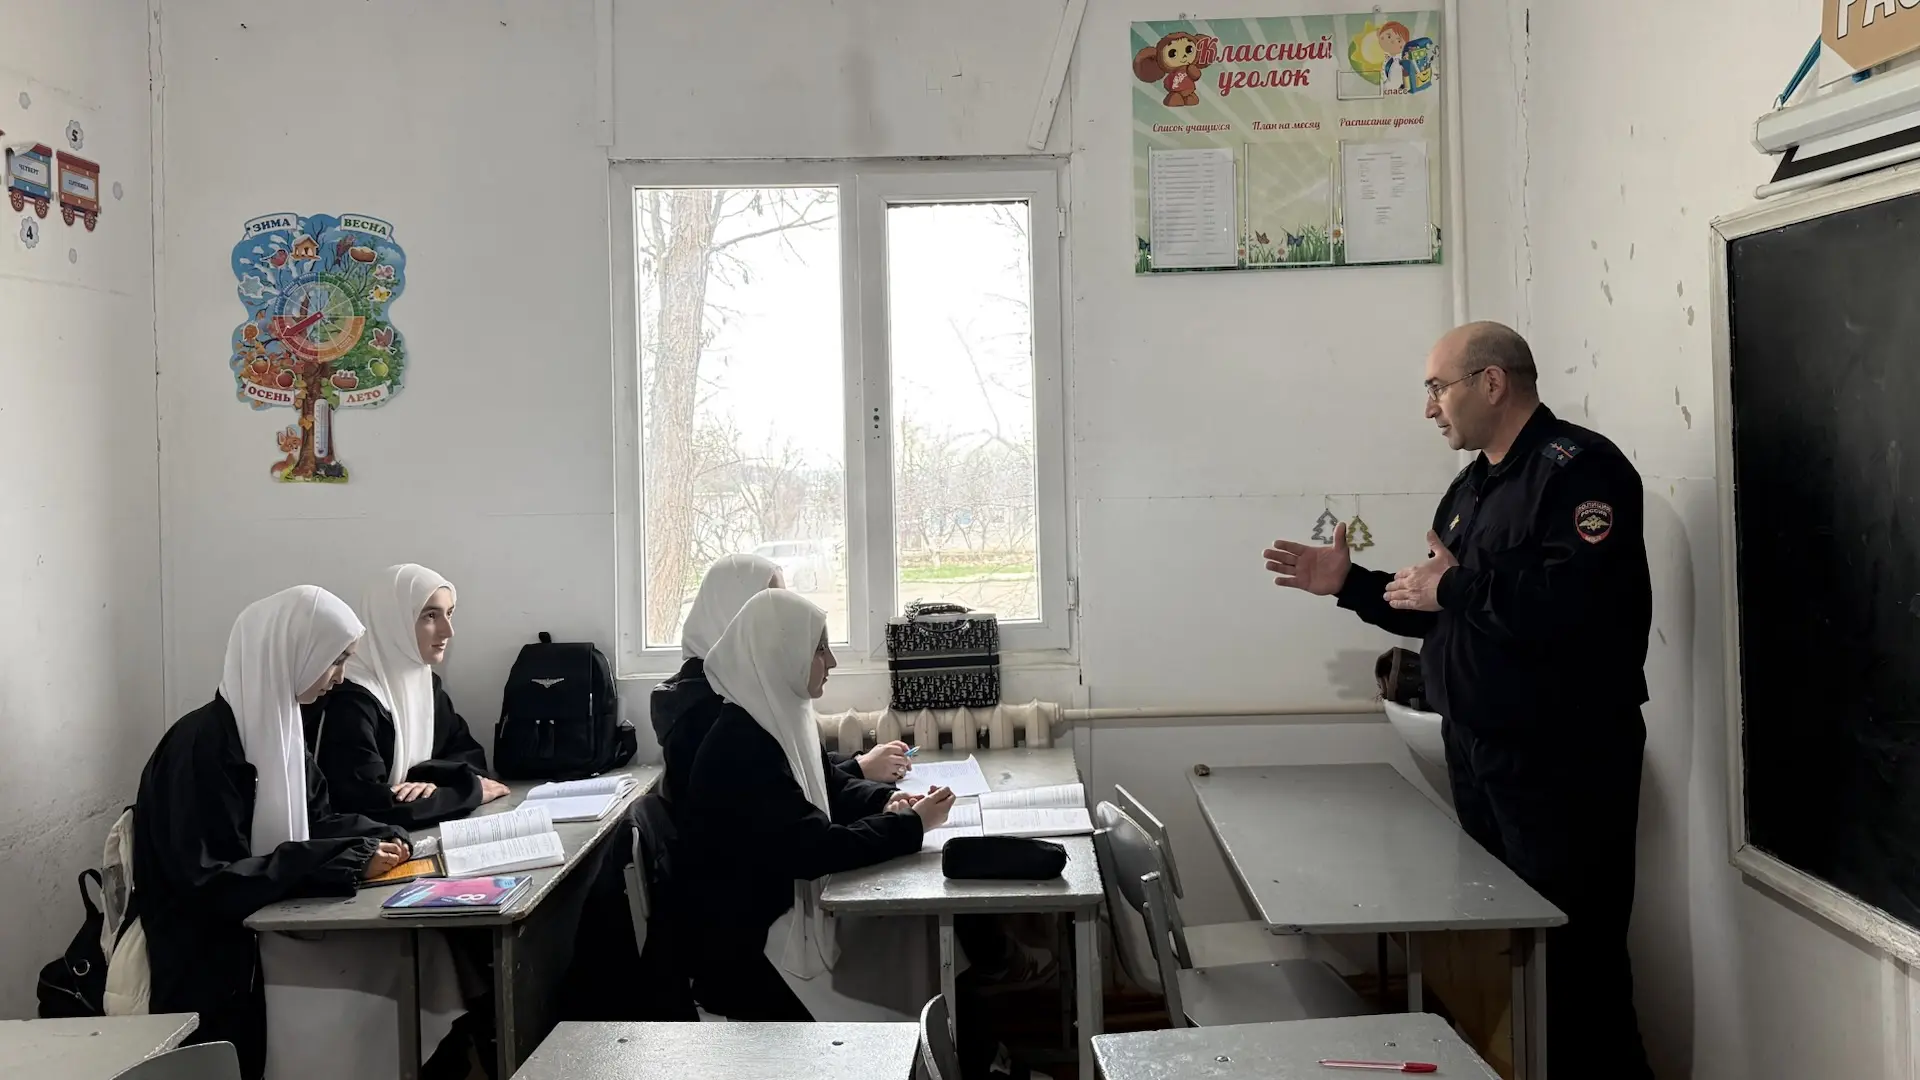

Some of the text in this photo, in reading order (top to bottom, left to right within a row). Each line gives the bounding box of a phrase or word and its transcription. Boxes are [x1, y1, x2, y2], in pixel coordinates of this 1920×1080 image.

[1837, 0, 1920, 39] РА
[1196, 34, 1333, 65] Классный
[1218, 69, 1310, 96] уголок
[1383, 87, 1408, 96] класс
[1152, 122, 1231, 133] Список учащихся
[1252, 121, 1321, 131] План на месяц
[1339, 115, 1425, 128] Расписание уроков
[72, 129, 78, 142] 5
[253, 219, 291, 231] ЗИМА
[343, 218, 387, 235] ВЕСНА
[26, 226, 33, 240] 4
[248, 387, 292, 402] ОСЕНЬ
[346, 389, 381, 403] ЛЕТО
